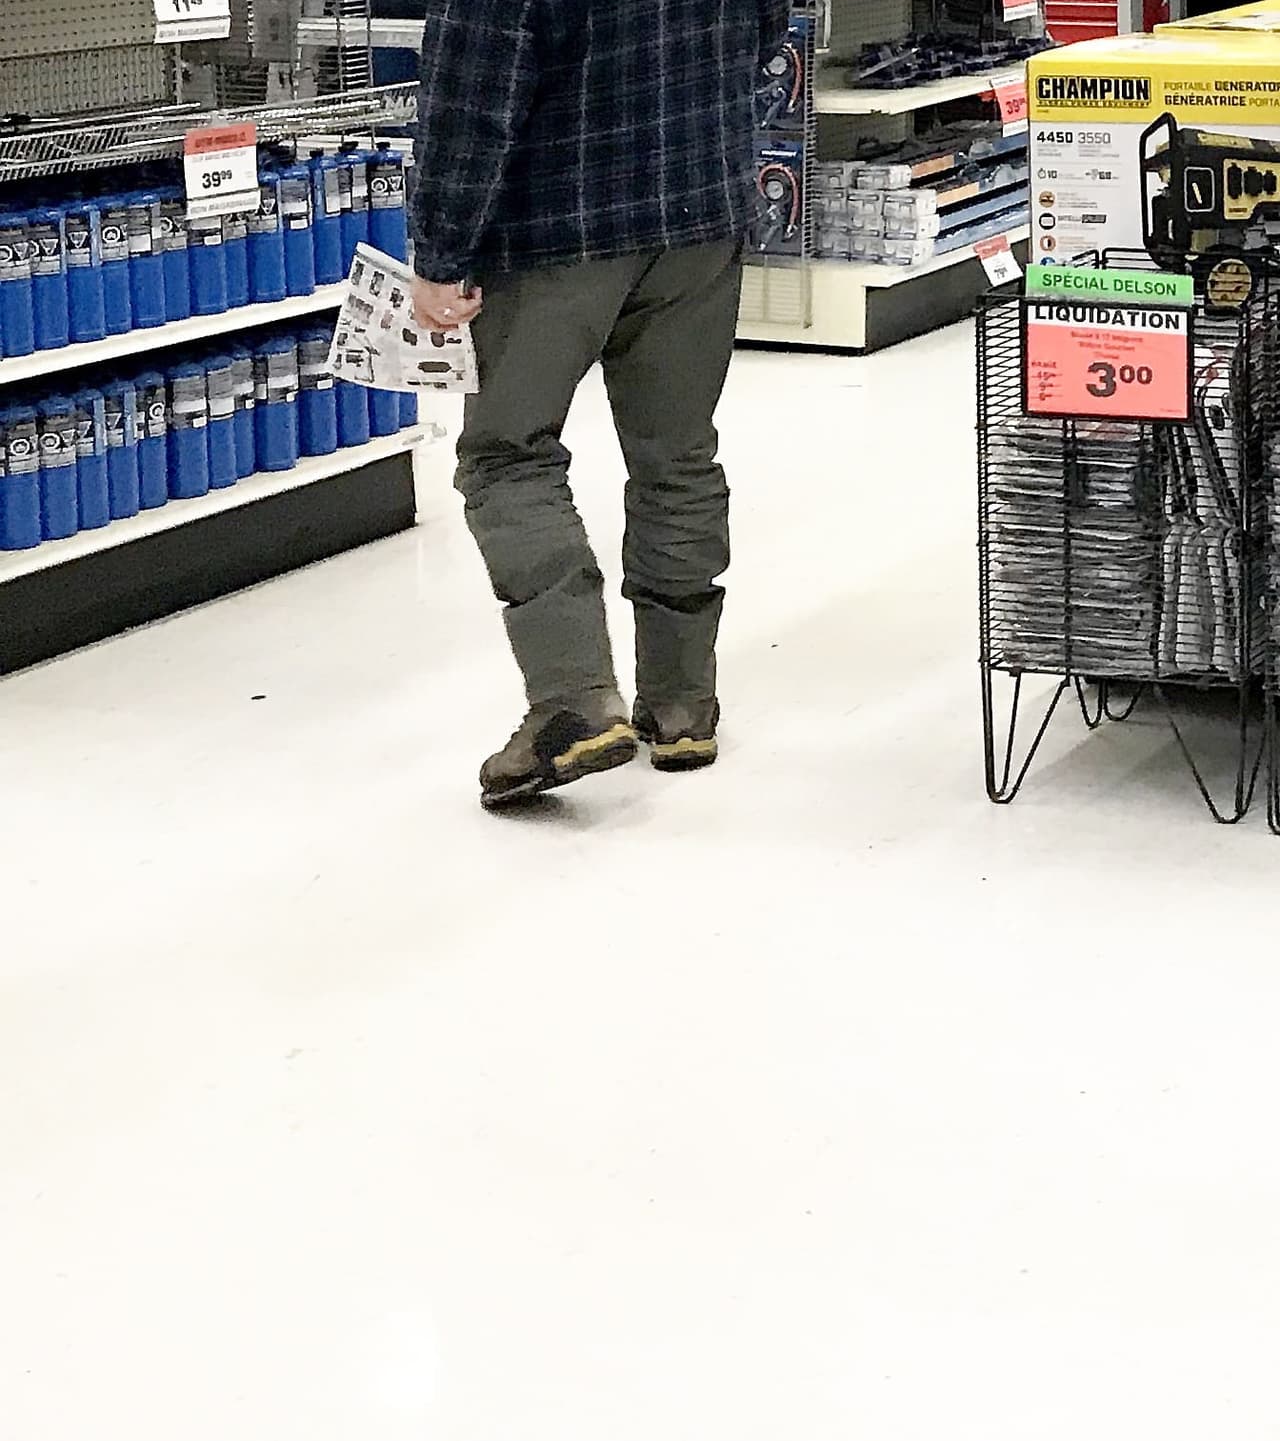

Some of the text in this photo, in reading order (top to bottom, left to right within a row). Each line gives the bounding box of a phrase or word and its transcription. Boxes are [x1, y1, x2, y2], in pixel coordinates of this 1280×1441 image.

[1037, 77, 1151, 101] CHAMPION
[1164, 93, 1246, 107] GÉNÉRATRICE
[1036, 131, 1112, 144] 4450 3550
[1042, 272, 1177, 296] SPÉCIAL DELSON
[1035, 306, 1180, 330] LIQUIDATION
